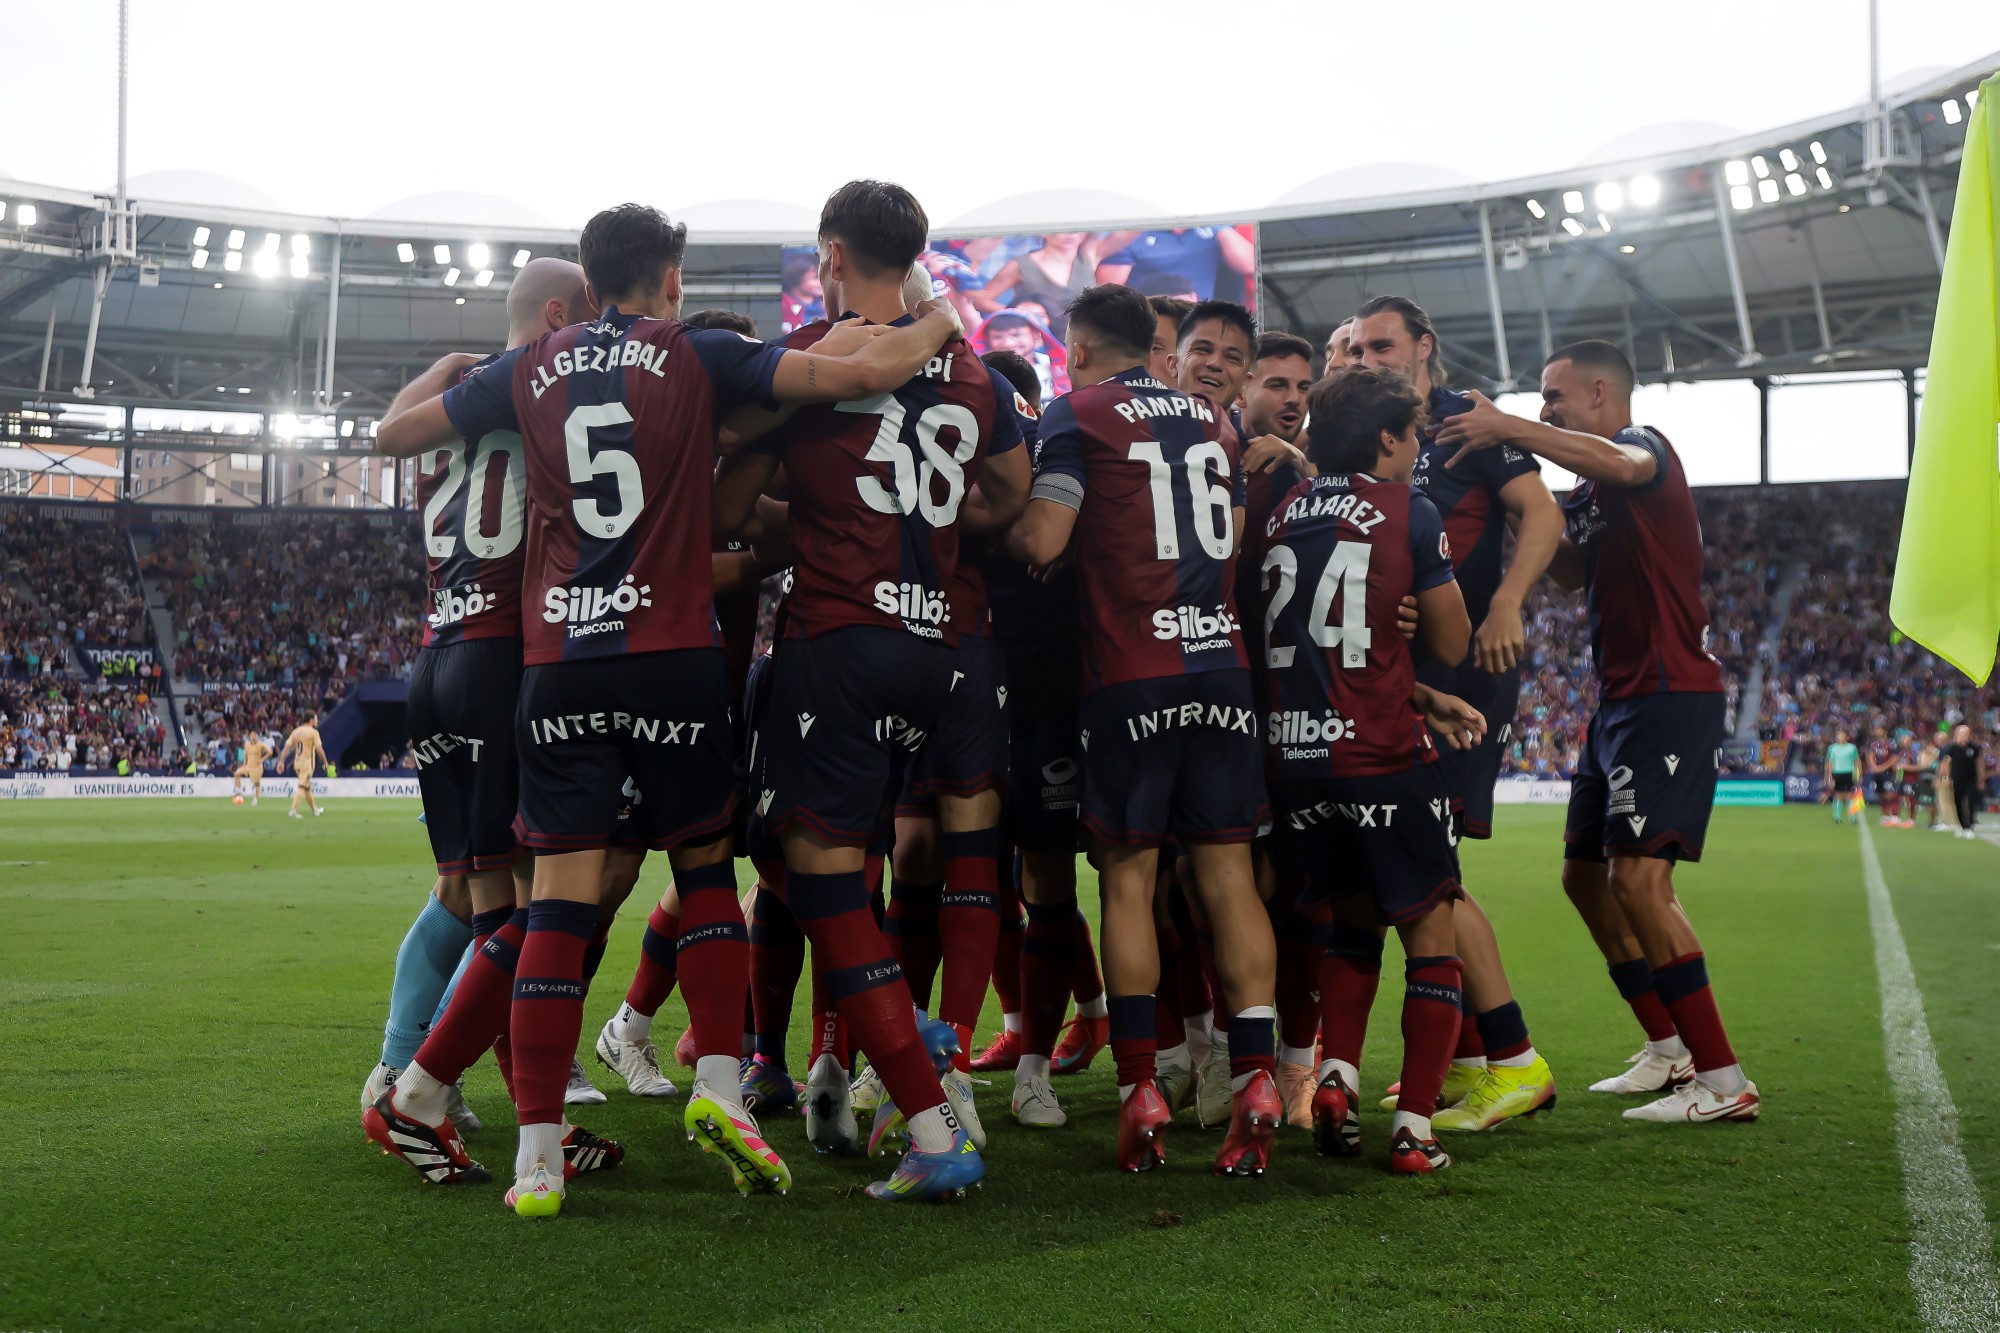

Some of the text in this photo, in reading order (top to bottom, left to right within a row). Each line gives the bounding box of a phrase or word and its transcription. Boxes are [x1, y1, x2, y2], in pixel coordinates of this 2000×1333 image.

[564, 401, 645, 539] 5
[834, 393, 980, 528] 38
[420, 428, 527, 559] 20
[1128, 441, 1234, 560] 16
[1266, 515, 1281, 538] C.
[1261, 541, 1373, 669] 24
[567, 620, 625, 639] Telecom
[902, 619, 943, 639] Telecom
[1181, 638, 1232, 654] Telecom
[531, 711, 705, 745] INTERNXT
[1127, 701, 1257, 742] INTERNX
[1281, 746, 1329, 760] Telecom
[521, 983, 582, 995] LEVANTE
